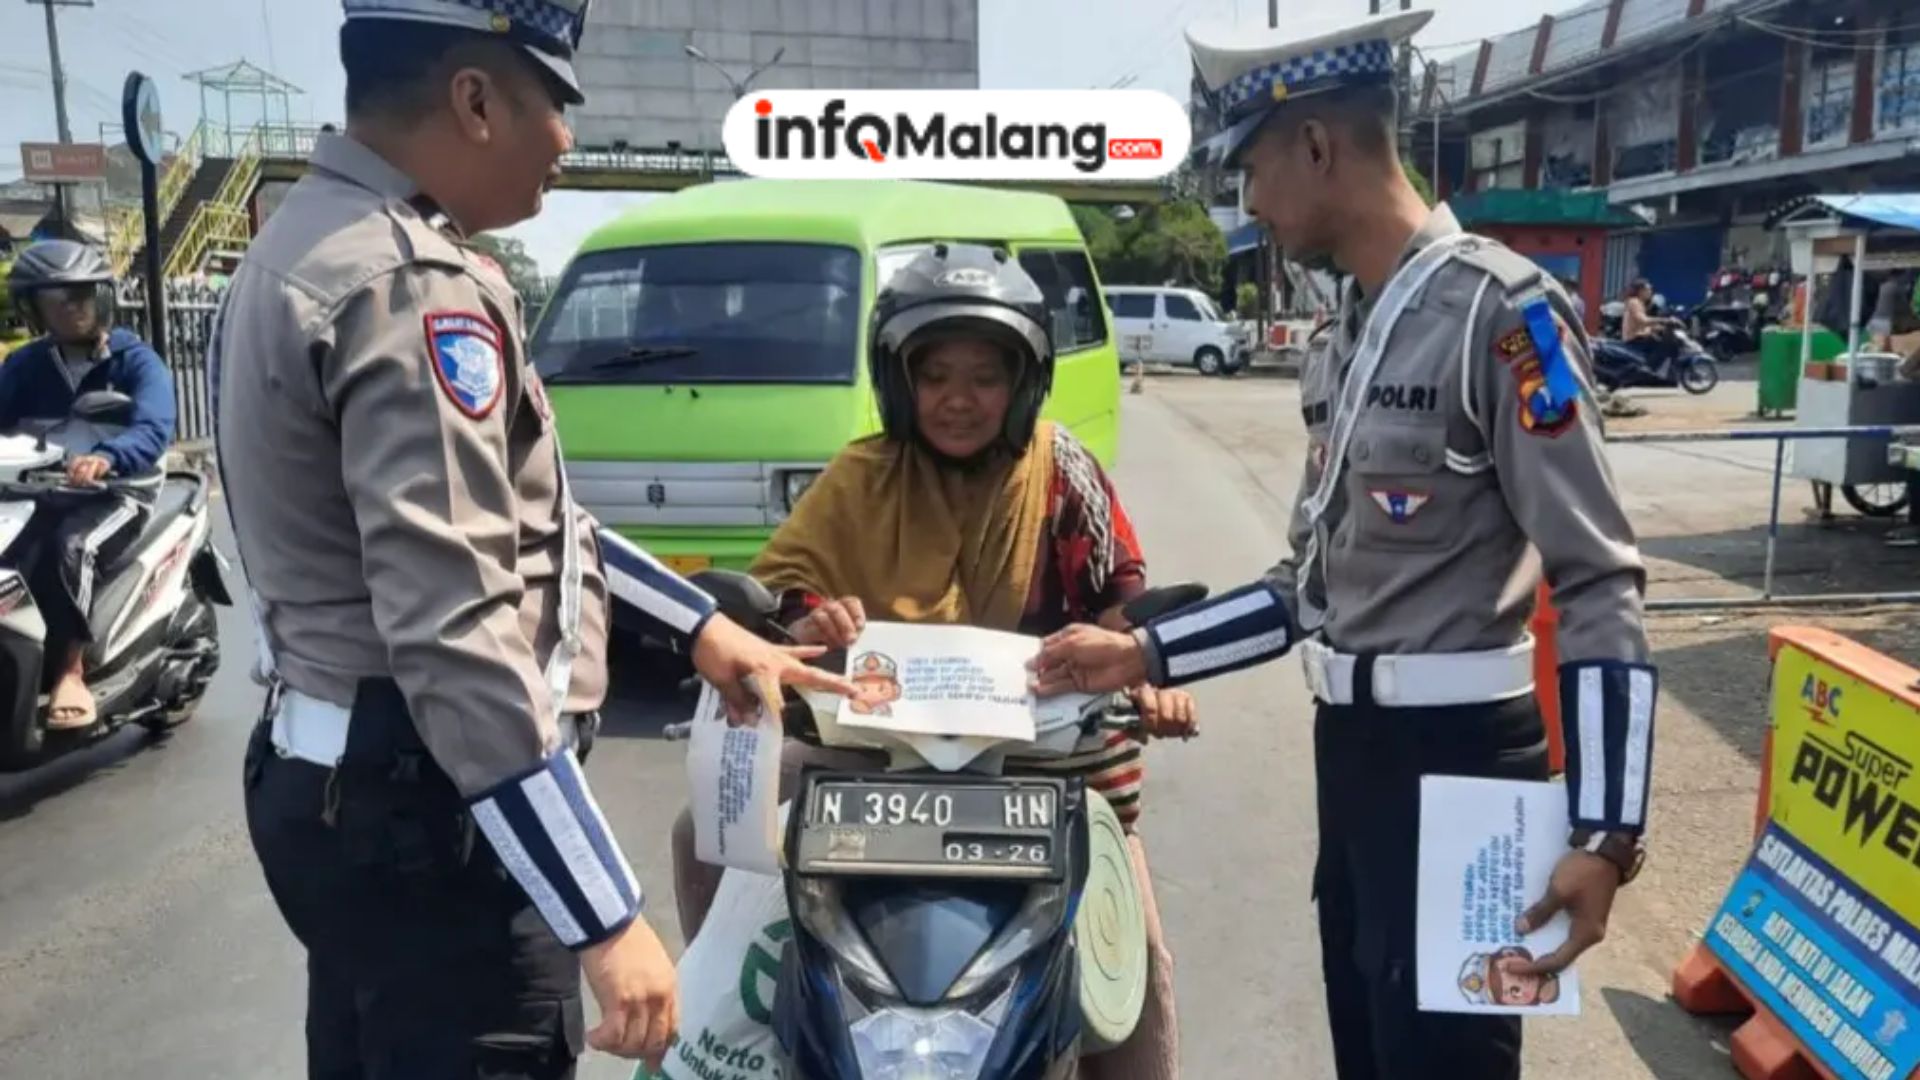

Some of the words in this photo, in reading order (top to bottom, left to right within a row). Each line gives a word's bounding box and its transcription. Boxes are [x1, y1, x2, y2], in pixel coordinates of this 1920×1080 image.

[1366, 384, 1437, 411] POLRI
[1802, 673, 1842, 717] ABC
[1805, 731, 1913, 789] Super
[823, 793, 842, 824] N
[864, 793, 953, 825] 3940
[1003, 795, 1050, 827] HN
[1790, 740, 1920, 869] POWE
[1756, 834, 1834, 908] SATLANTAS
[1825, 886, 1891, 951] POLRES
[1880, 931, 1920, 989] MAL
[1785, 932, 1822, 972] HATI
[1812, 954, 1836, 985] DI
[1827, 967, 1875, 1018] JALAN
